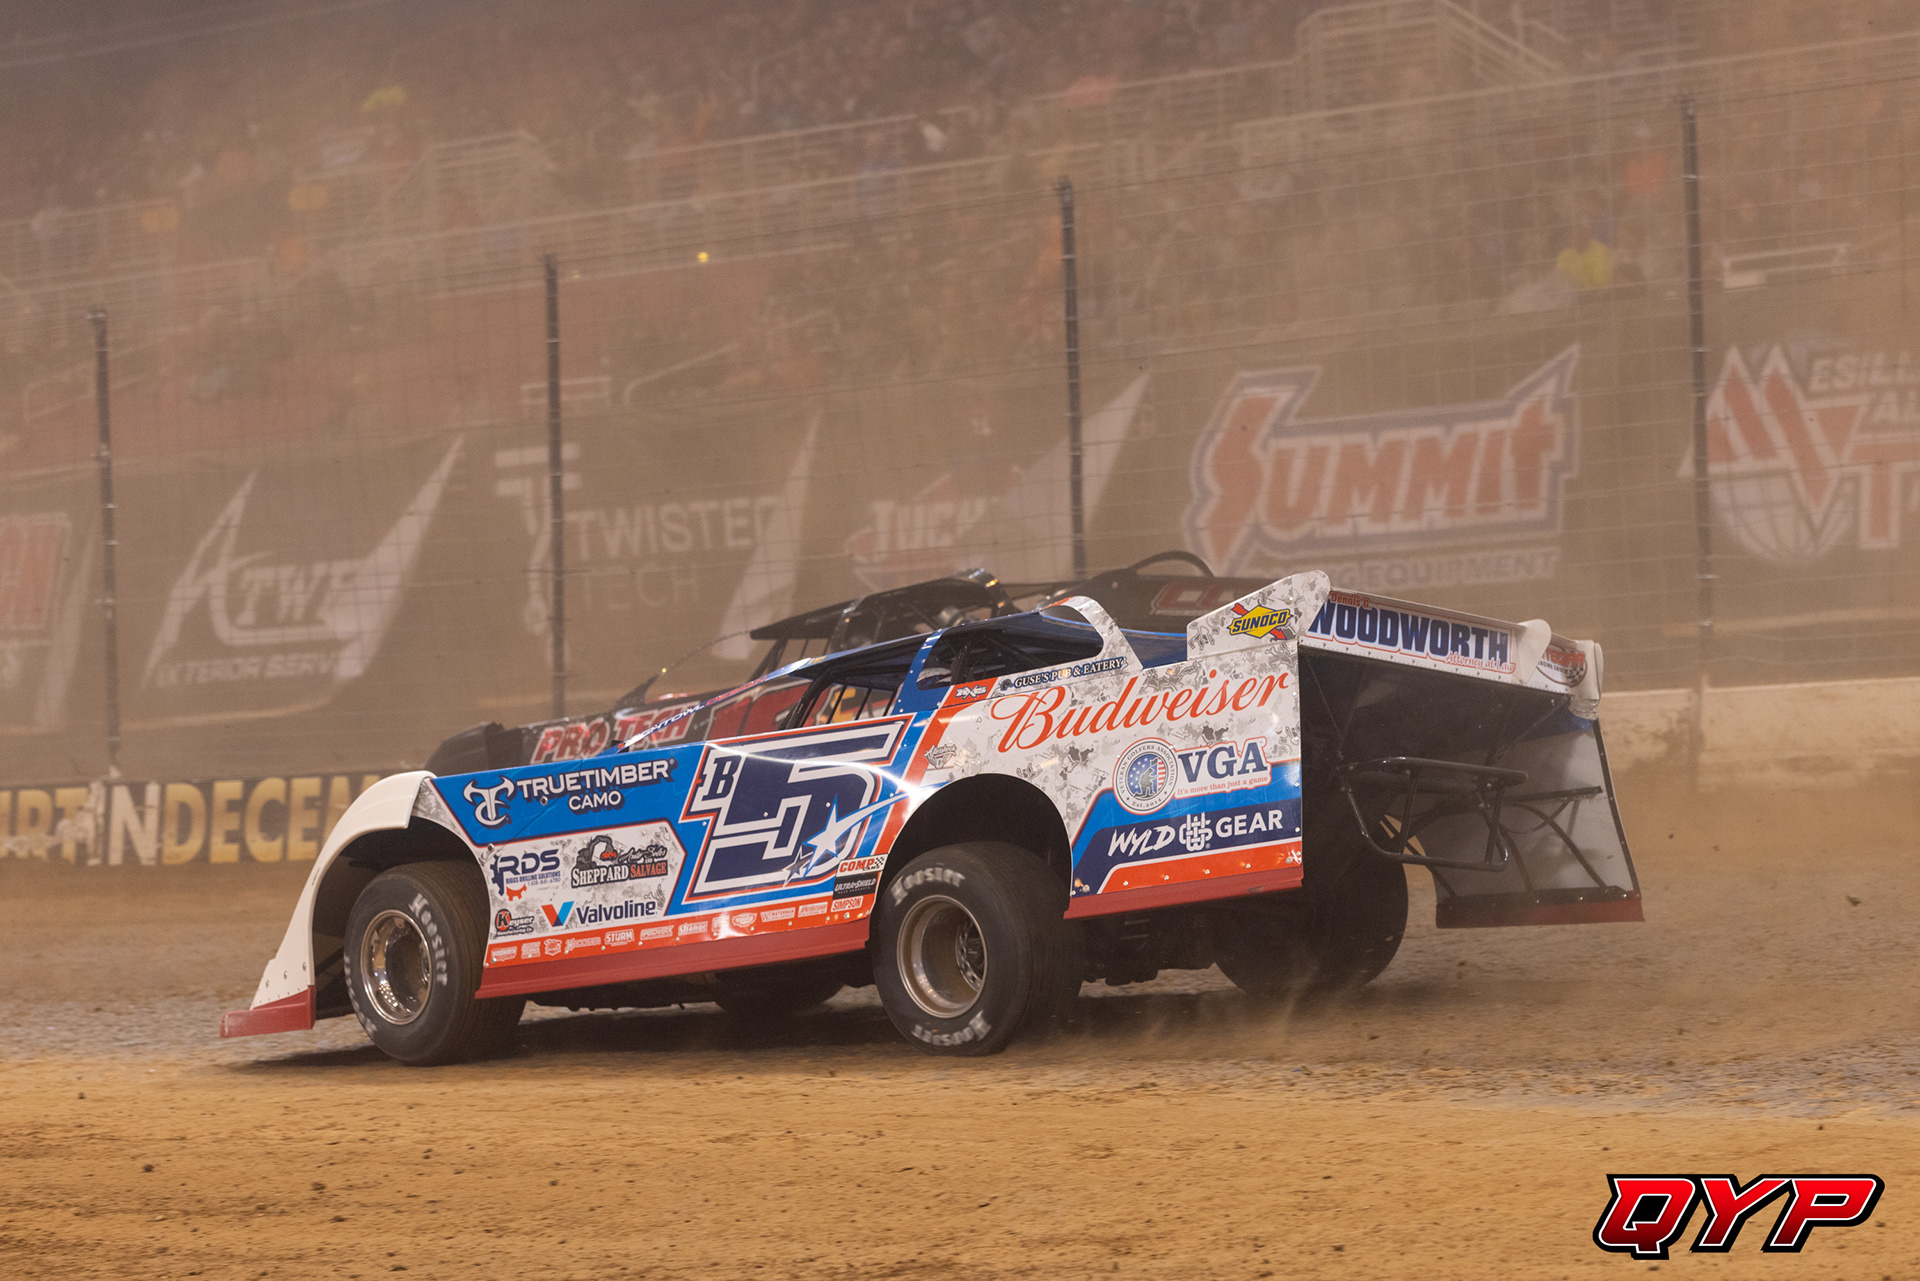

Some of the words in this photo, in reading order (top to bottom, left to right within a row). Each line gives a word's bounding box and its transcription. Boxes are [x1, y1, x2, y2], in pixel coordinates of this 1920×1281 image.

[1330, 592, 1361, 607] Dennis
[1233, 612, 1287, 634] SUNOCO
[1309, 599, 1508, 666] WOODWORTH
[1446, 651, 1483, 670] Attorney
[1485, 657, 1494, 668] at
[1496, 660, 1516, 672] Law
[1541, 648, 1585, 667] TEGRA
[1014, 672, 1049, 688] GUSE'S
[1051, 667, 1071, 681] PUB
[1073, 665, 1081, 676] &
[1083, 658, 1123, 674] EATERY
[990, 670, 1289, 753] Budweiser
[531, 721, 609, 764] PRO
[1178, 742, 1267, 783] VGA
[517, 760, 670, 799] TRUETIMBER
[1177, 788, 1188, 796] It's
[1190, 785, 1208, 794] more
[1210, 783, 1226, 791] than
[1227, 780, 1241, 791] just
[1248, 776, 1268, 786] game
[568, 791, 622, 812] CAMO
[697, 724, 899, 893] 5
[1108, 825, 1176, 857] WYLD
[1216, 809, 1283, 838] GEAR
[494, 849, 561, 895] RDS
[572, 865, 629, 887] SHEPPARD
[630, 862, 667, 878] SALVAGE
[840, 858, 875, 873] COMP
[576, 900, 656, 924] Valvoline
[832, 898, 863, 912] SIMPSON
[496, 911, 534, 930] Keyser
